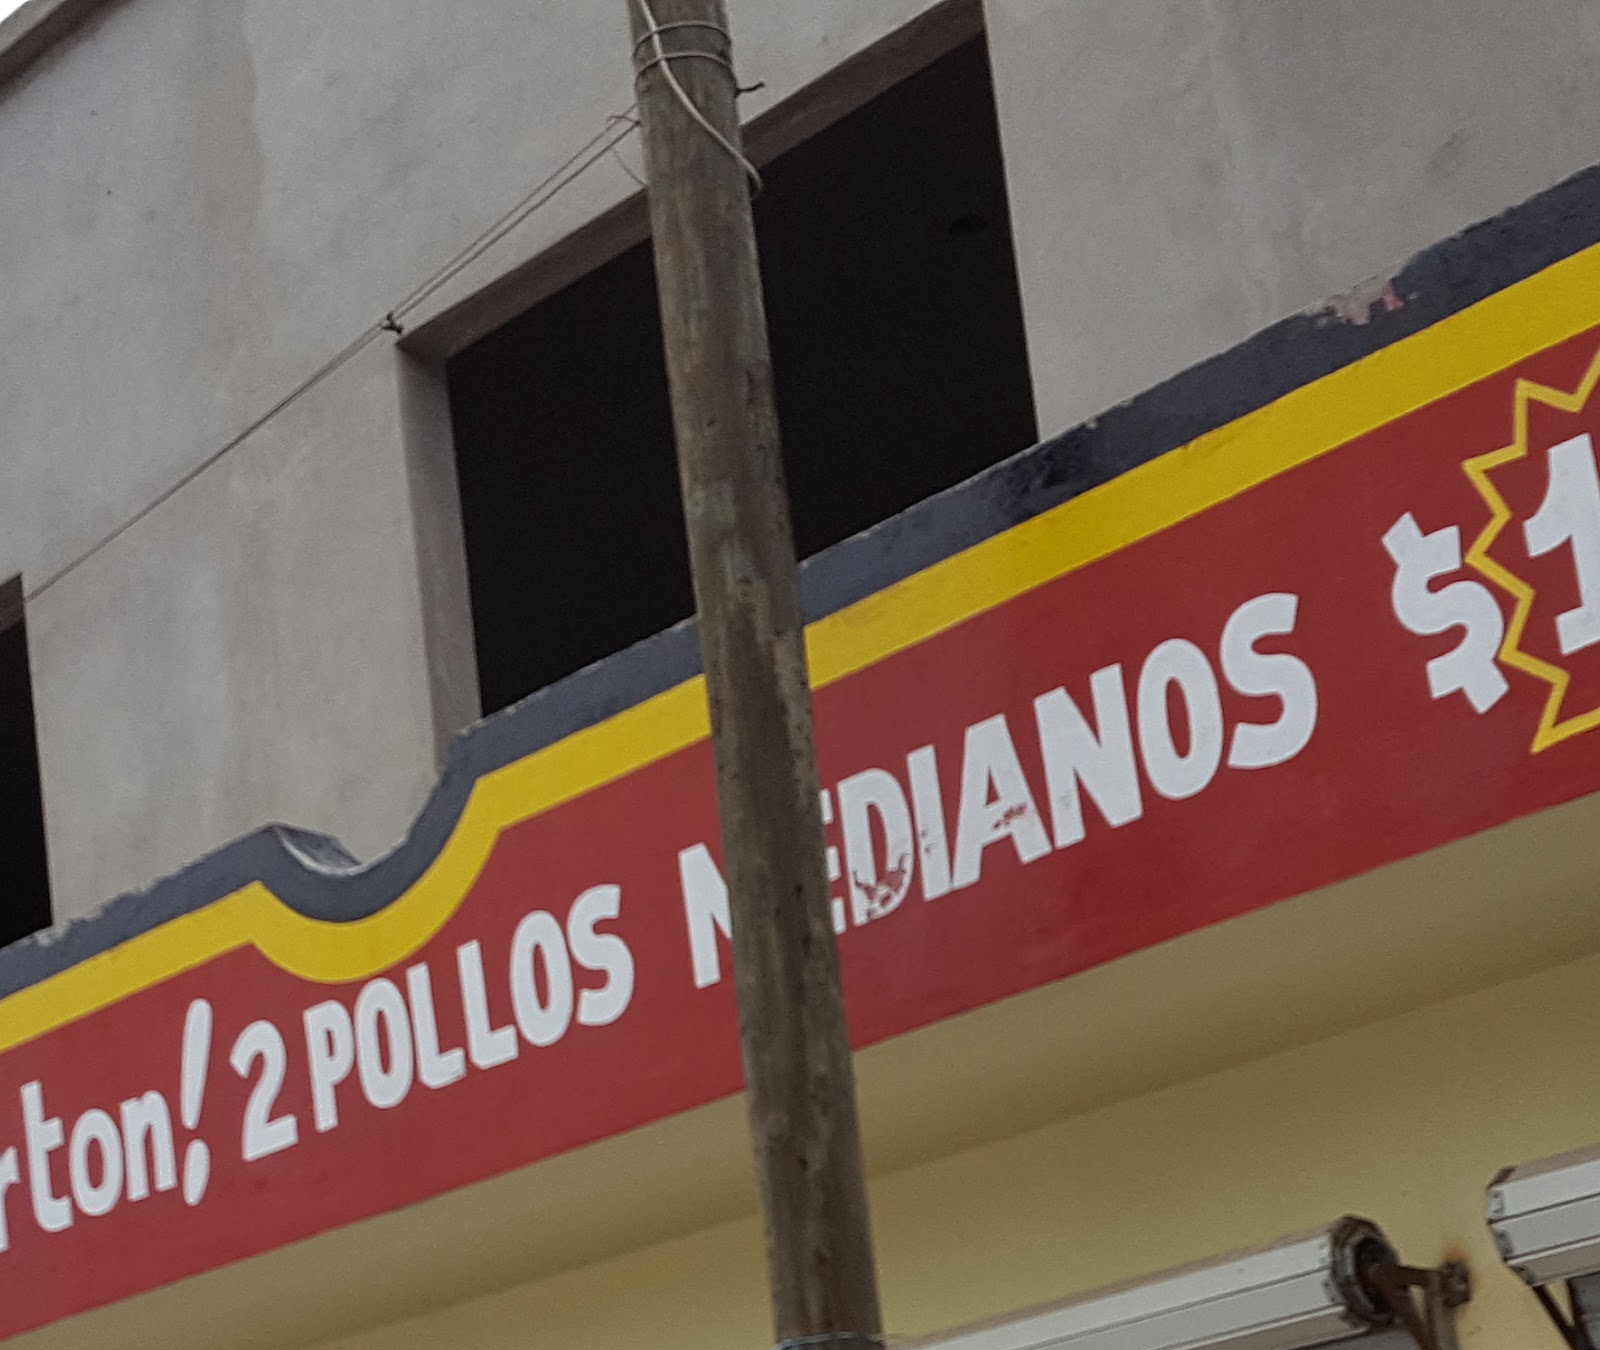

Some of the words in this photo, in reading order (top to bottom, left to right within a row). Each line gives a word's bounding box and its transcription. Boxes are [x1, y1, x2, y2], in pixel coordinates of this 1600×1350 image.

[228, 1018, 298, 1163] 2
[302, 884, 635, 1133] POLLOS
[677, 592, 1318, 990] MDIANOS
